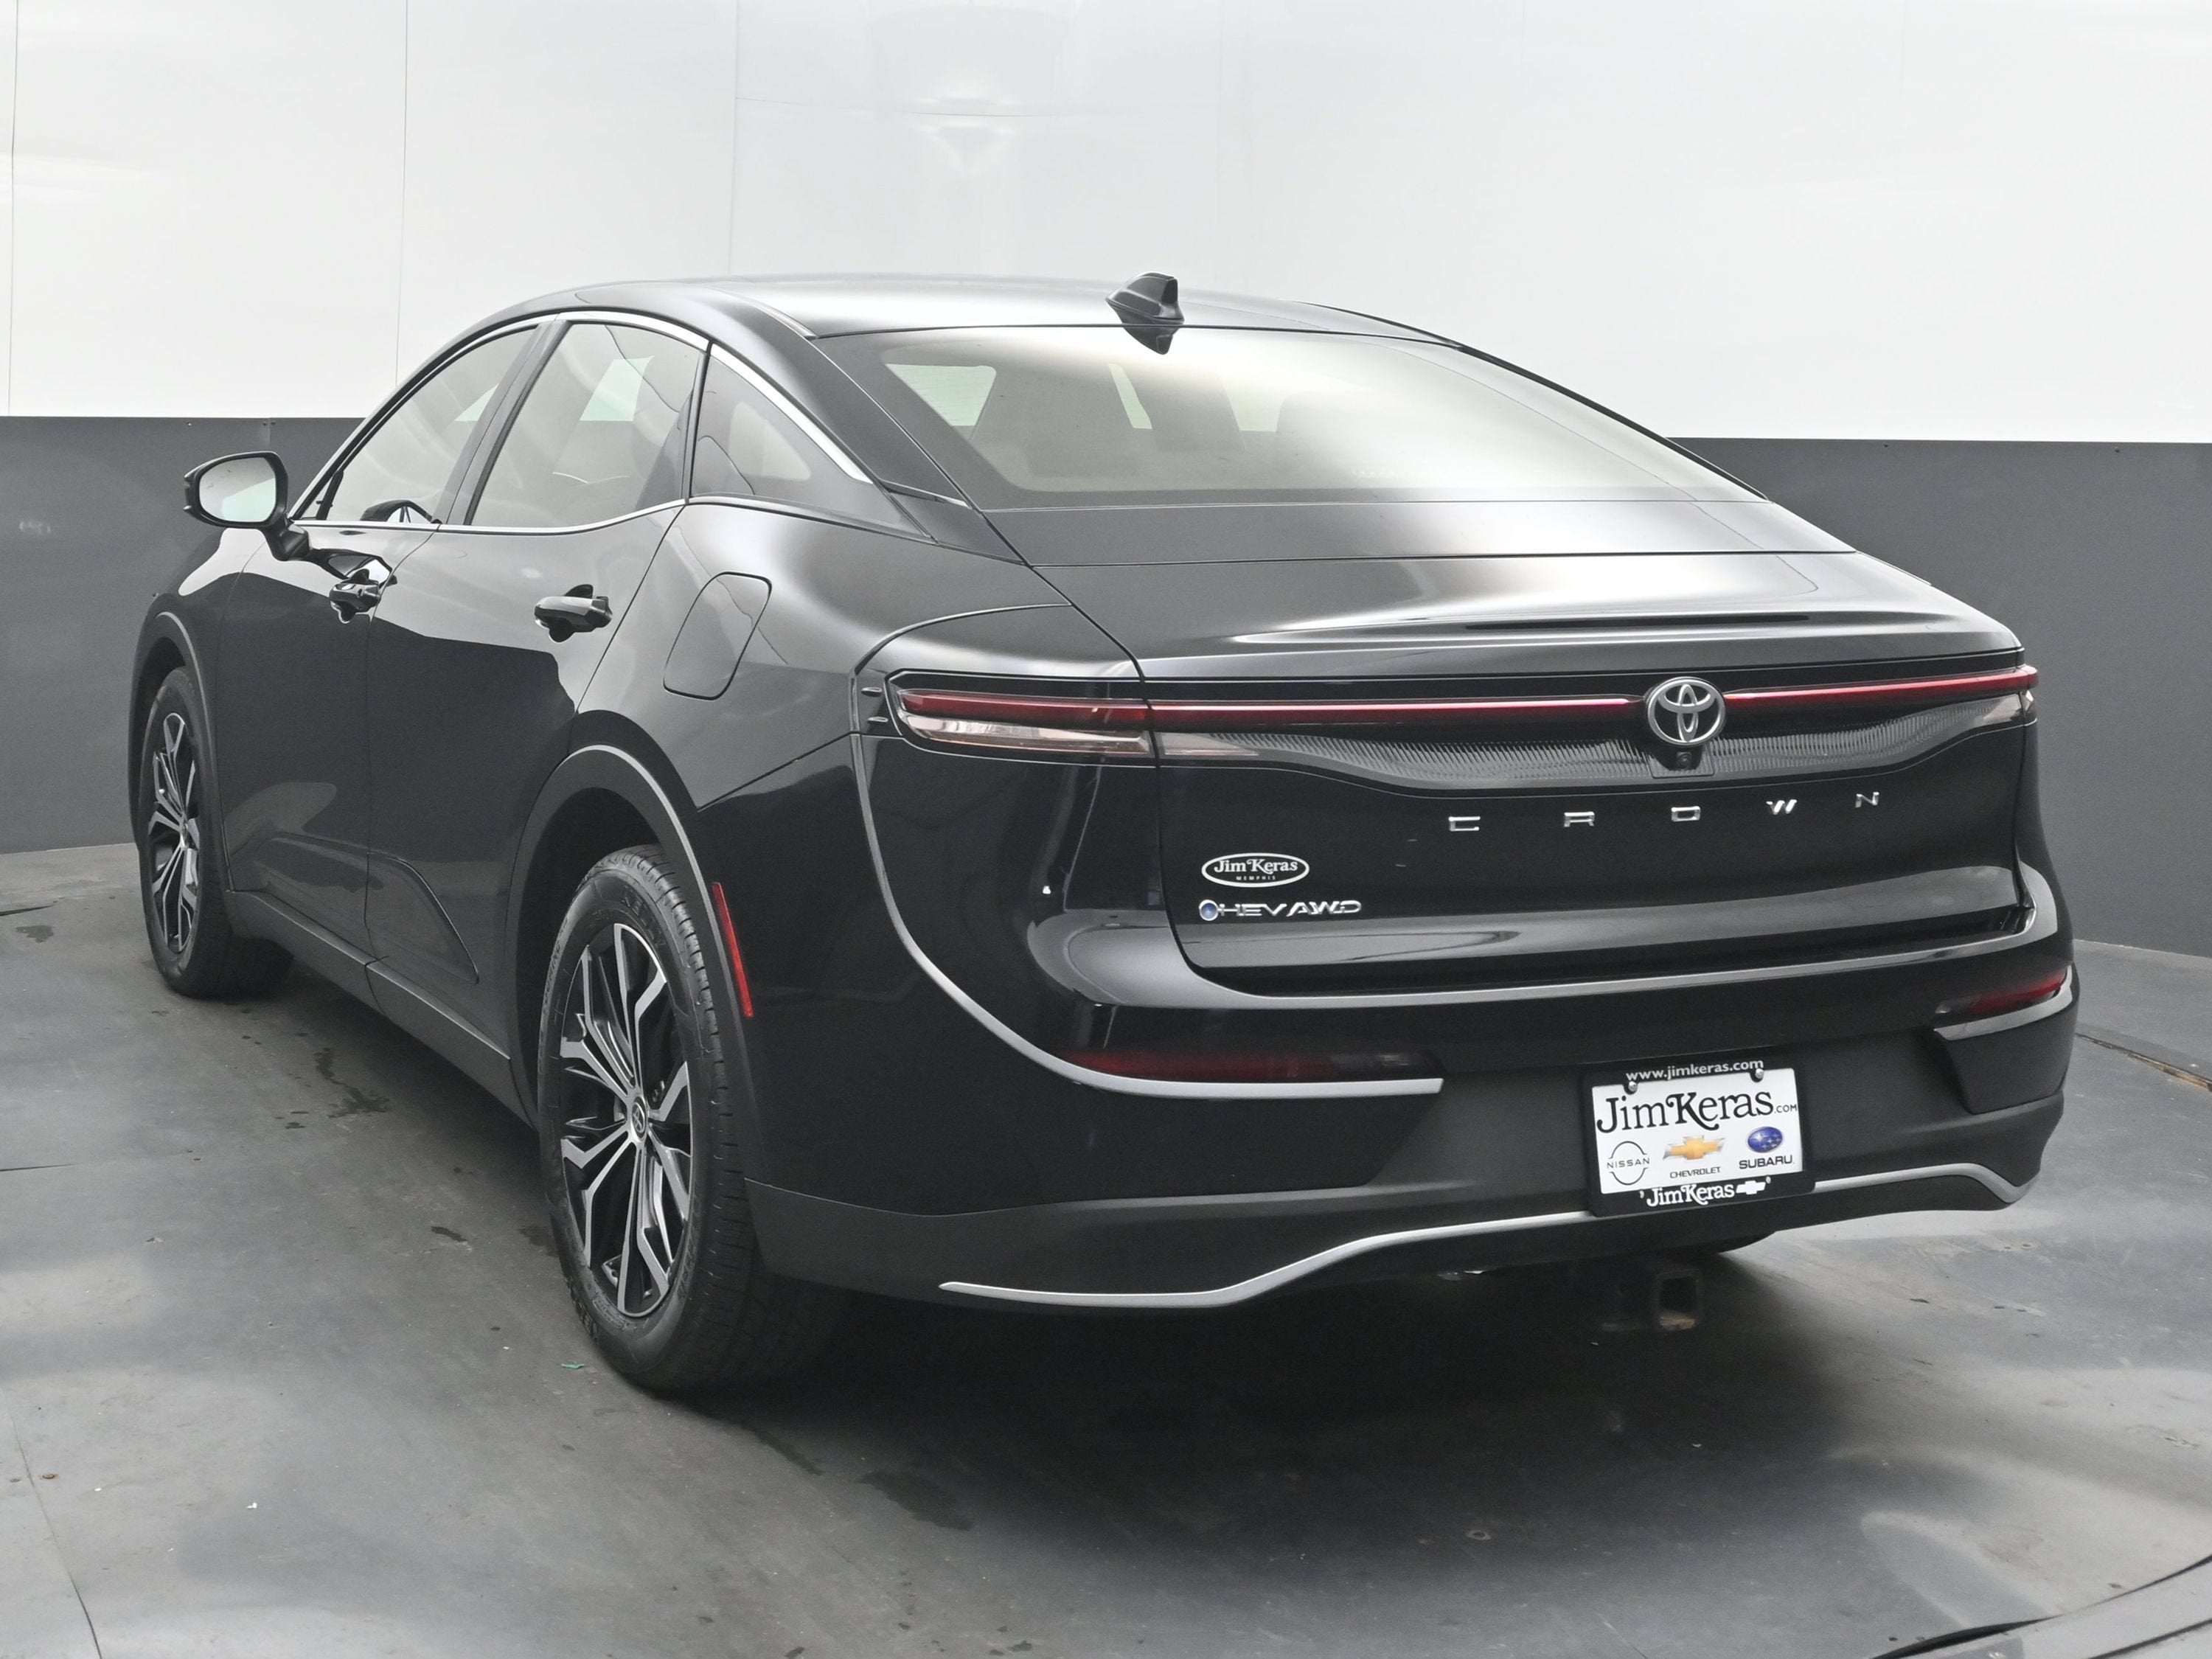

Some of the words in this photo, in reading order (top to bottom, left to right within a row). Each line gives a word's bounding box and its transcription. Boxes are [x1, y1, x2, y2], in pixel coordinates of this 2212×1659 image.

[1448, 791, 1879, 832] CROWN
[1625, 1060, 1764, 1082] www.jimkeras.com
[1607, 1158, 1650, 1169] NISSAN
[1739, 1155, 1793, 1169] SUBARU
[1669, 1166, 1722, 1179] CHEVROLET
